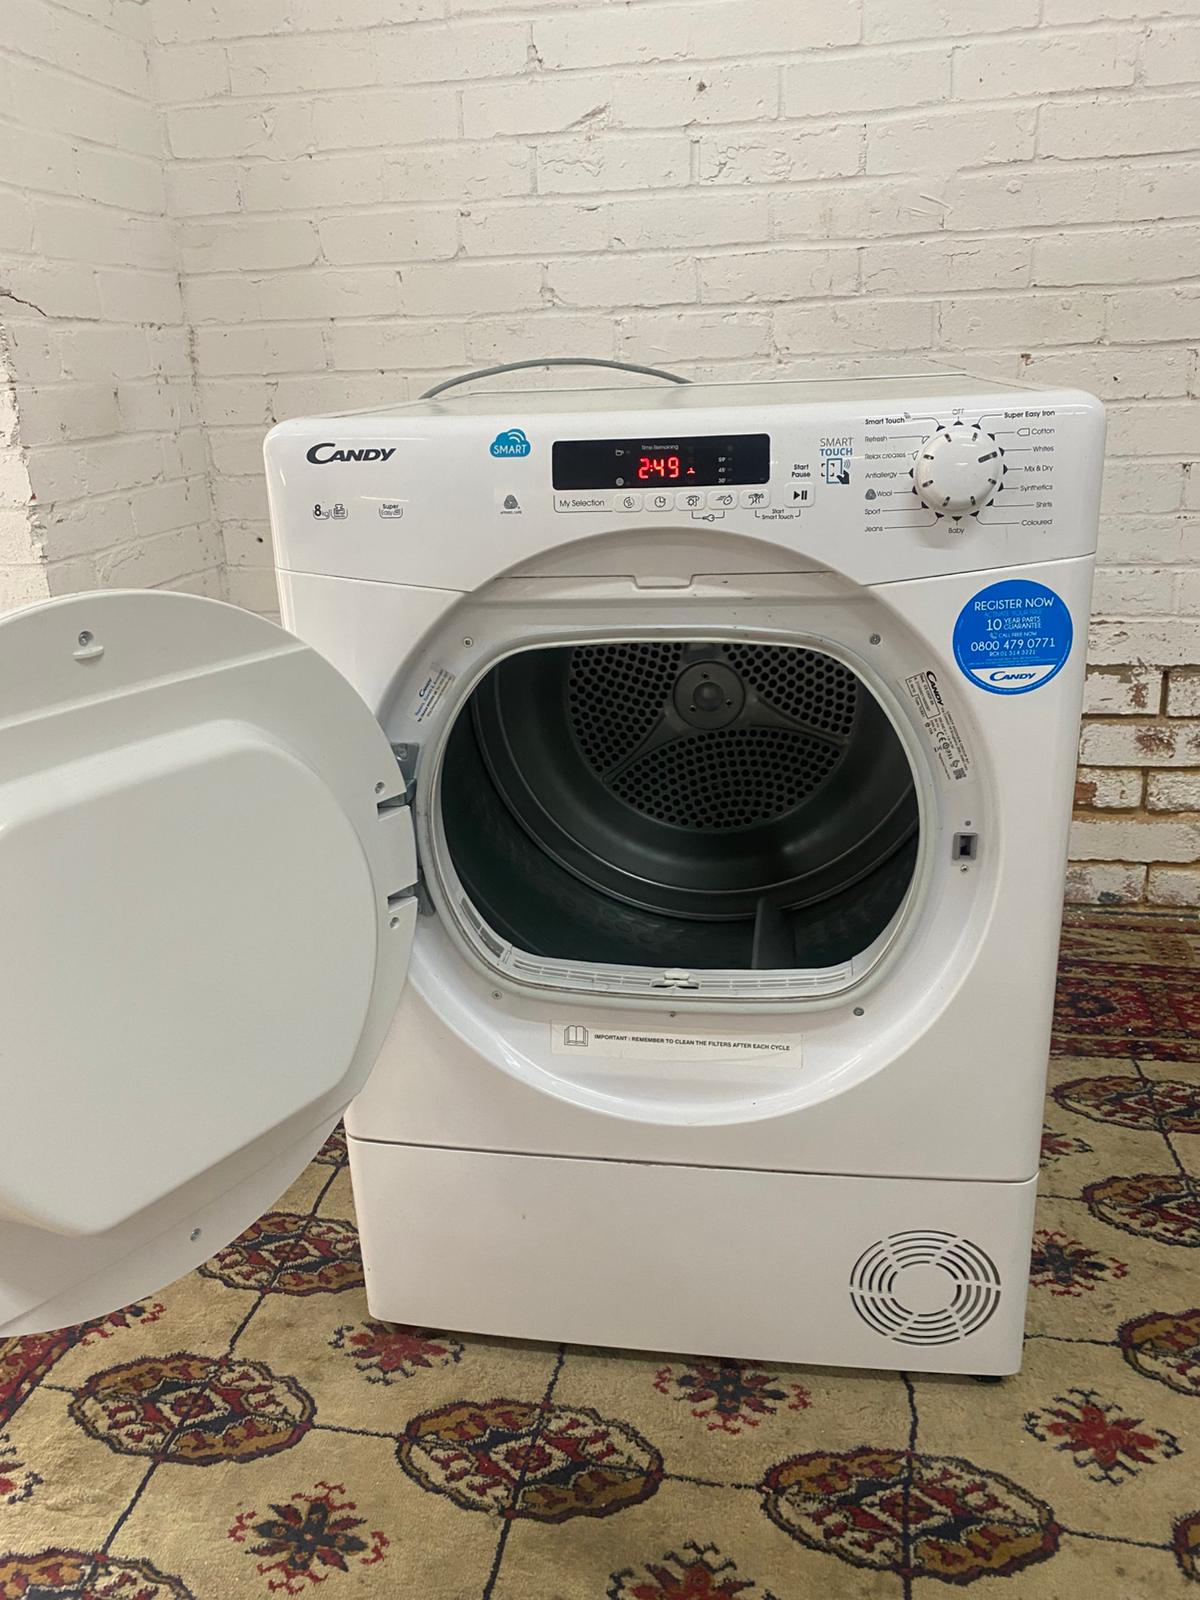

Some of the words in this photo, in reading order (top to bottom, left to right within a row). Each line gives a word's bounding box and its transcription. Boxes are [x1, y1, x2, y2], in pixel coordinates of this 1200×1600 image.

[1004, 411, 1024, 419] Super
[1025, 410, 1041, 419] Easy
[1031, 427, 1056, 435] Cotton
[819, 437, 855, 447] SMART
[306, 442, 397, 465] CANDY
[493, 444, 528, 455] SMART
[819, 447, 853, 457] TOUCH
[1033, 445, 1055, 453] Whites
[638, 456, 680, 479] 2:49
[793, 463, 809, 471] Start
[1024, 465, 1035, 473] Mix
[1042, 464, 1054, 473] Dry
[791, 471, 811, 479] Pause
[864, 471, 898, 480] Antiallergy
[1020, 484, 1054, 492] Synthetics
[382, 503, 399, 511] Super
[559, 499, 570, 508] My
[571, 499, 605, 507] Selection
[864, 508, 881, 517] Sport
[1021, 519, 1053, 527] Coloured
[948, 527, 965, 535] Baby
[974, 598, 1023, 612] REGISTER
[1025, 596, 1055, 608] NOW
[986, 618, 1003, 632] 10
[970, 641, 1000, 652] 0800
[1003, 639, 1025, 650] 479
[1026, 637, 1056, 649] 0771
[989, 671, 1037, 682] CANDY
[926, 670, 944, 706] CANDY
[631, 1036, 665, 1044] REMEMBER
[708, 1040, 732, 1048] FILTERS
